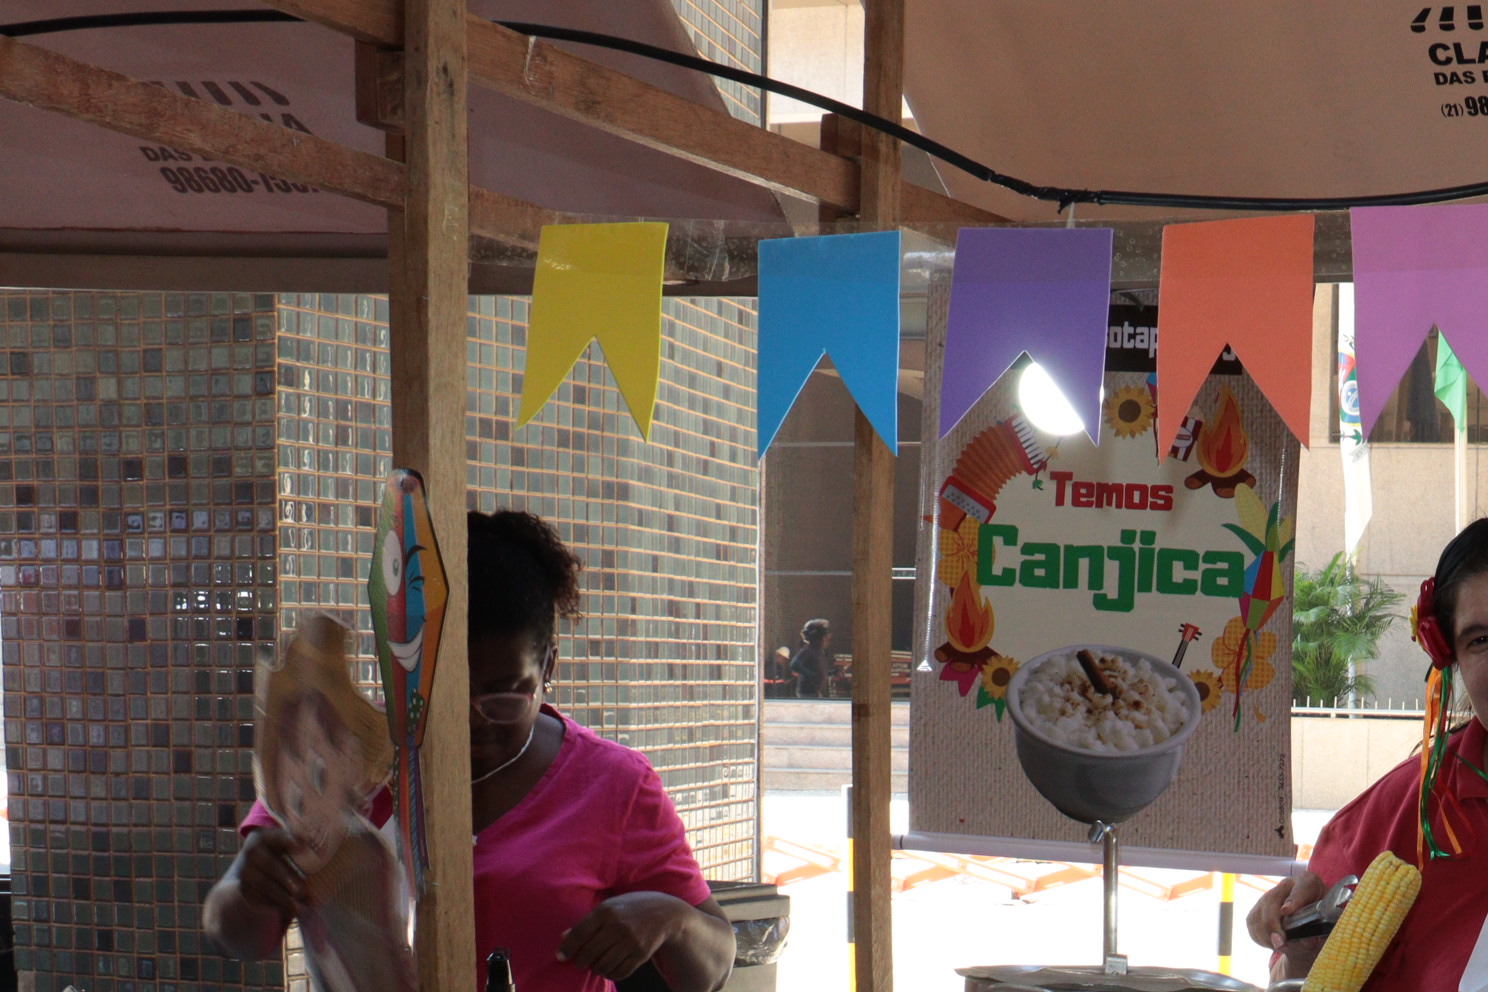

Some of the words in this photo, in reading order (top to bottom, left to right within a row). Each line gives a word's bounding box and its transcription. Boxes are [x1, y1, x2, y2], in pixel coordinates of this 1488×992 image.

[1434, 70, 1476, 86] DAS
[1441, 102, 1464, 118] (21)
[1050, 471, 1173, 511] Temos
[976, 523, 1245, 612] Canjica
